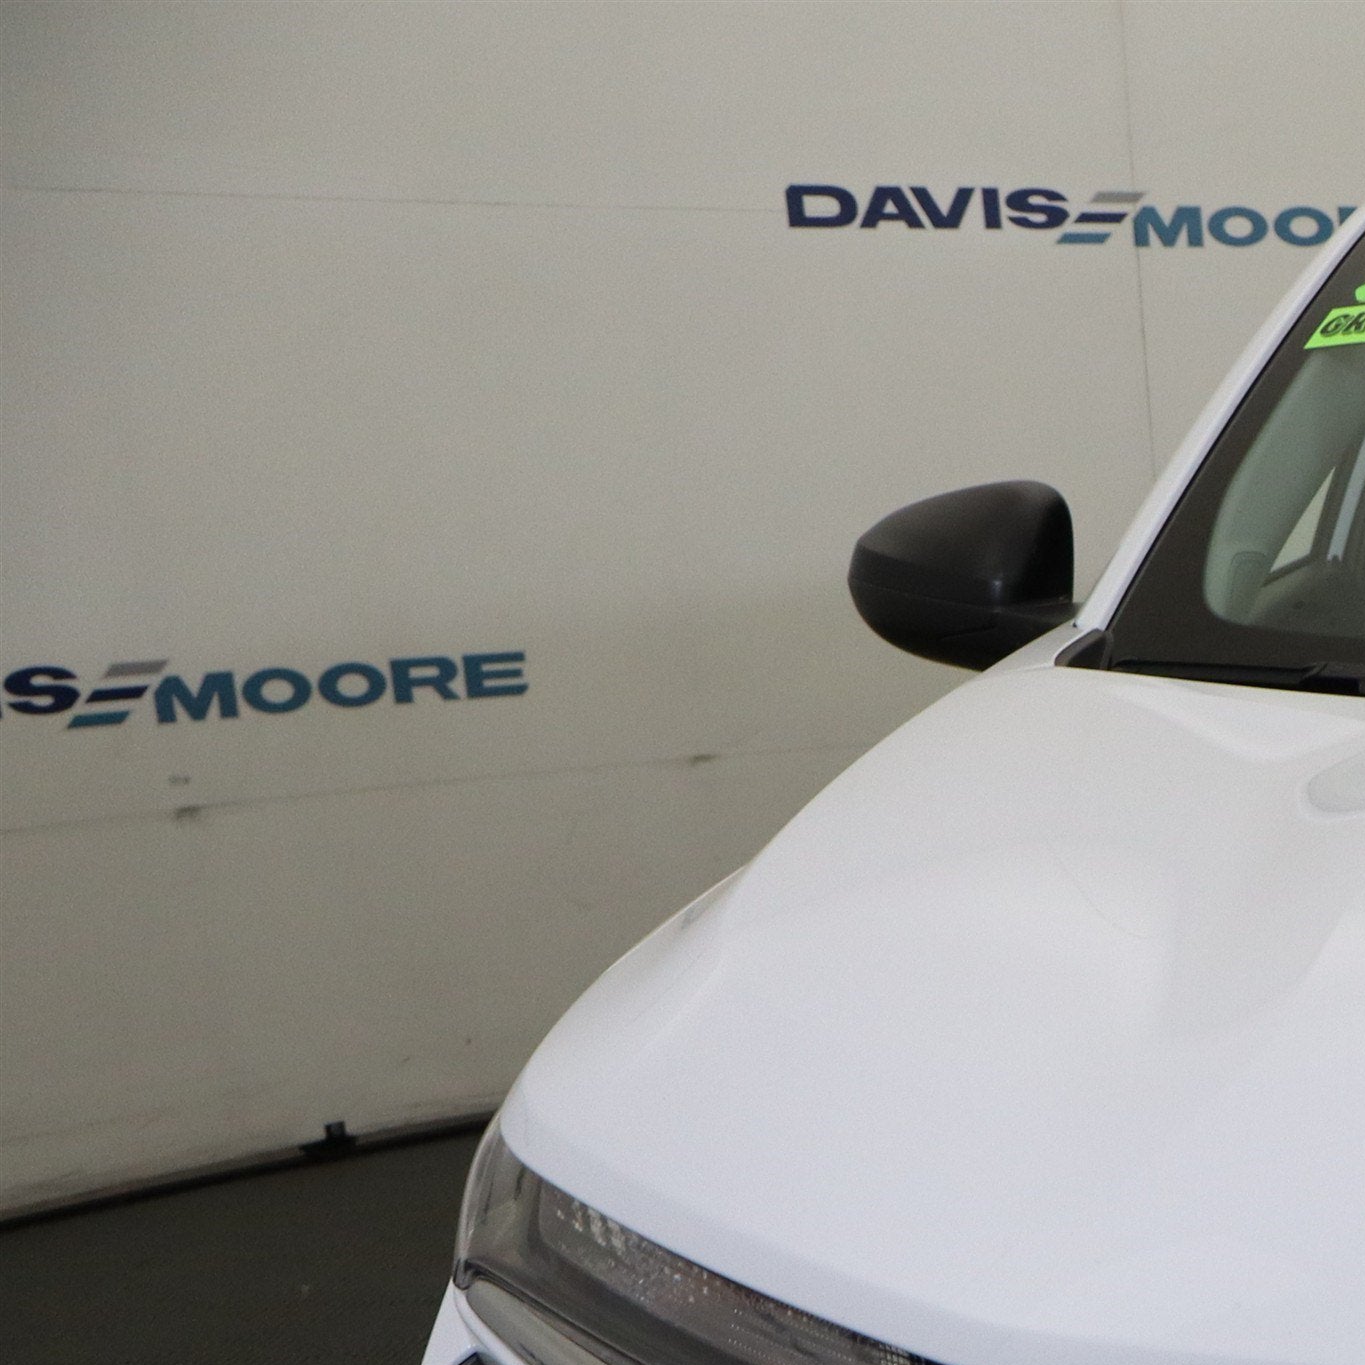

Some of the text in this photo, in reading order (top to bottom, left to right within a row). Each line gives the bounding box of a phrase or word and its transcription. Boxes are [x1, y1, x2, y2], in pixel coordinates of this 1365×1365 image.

[784, 184, 1360, 249] DAVIS MOO
[152, 650, 530, 726] MOORE
